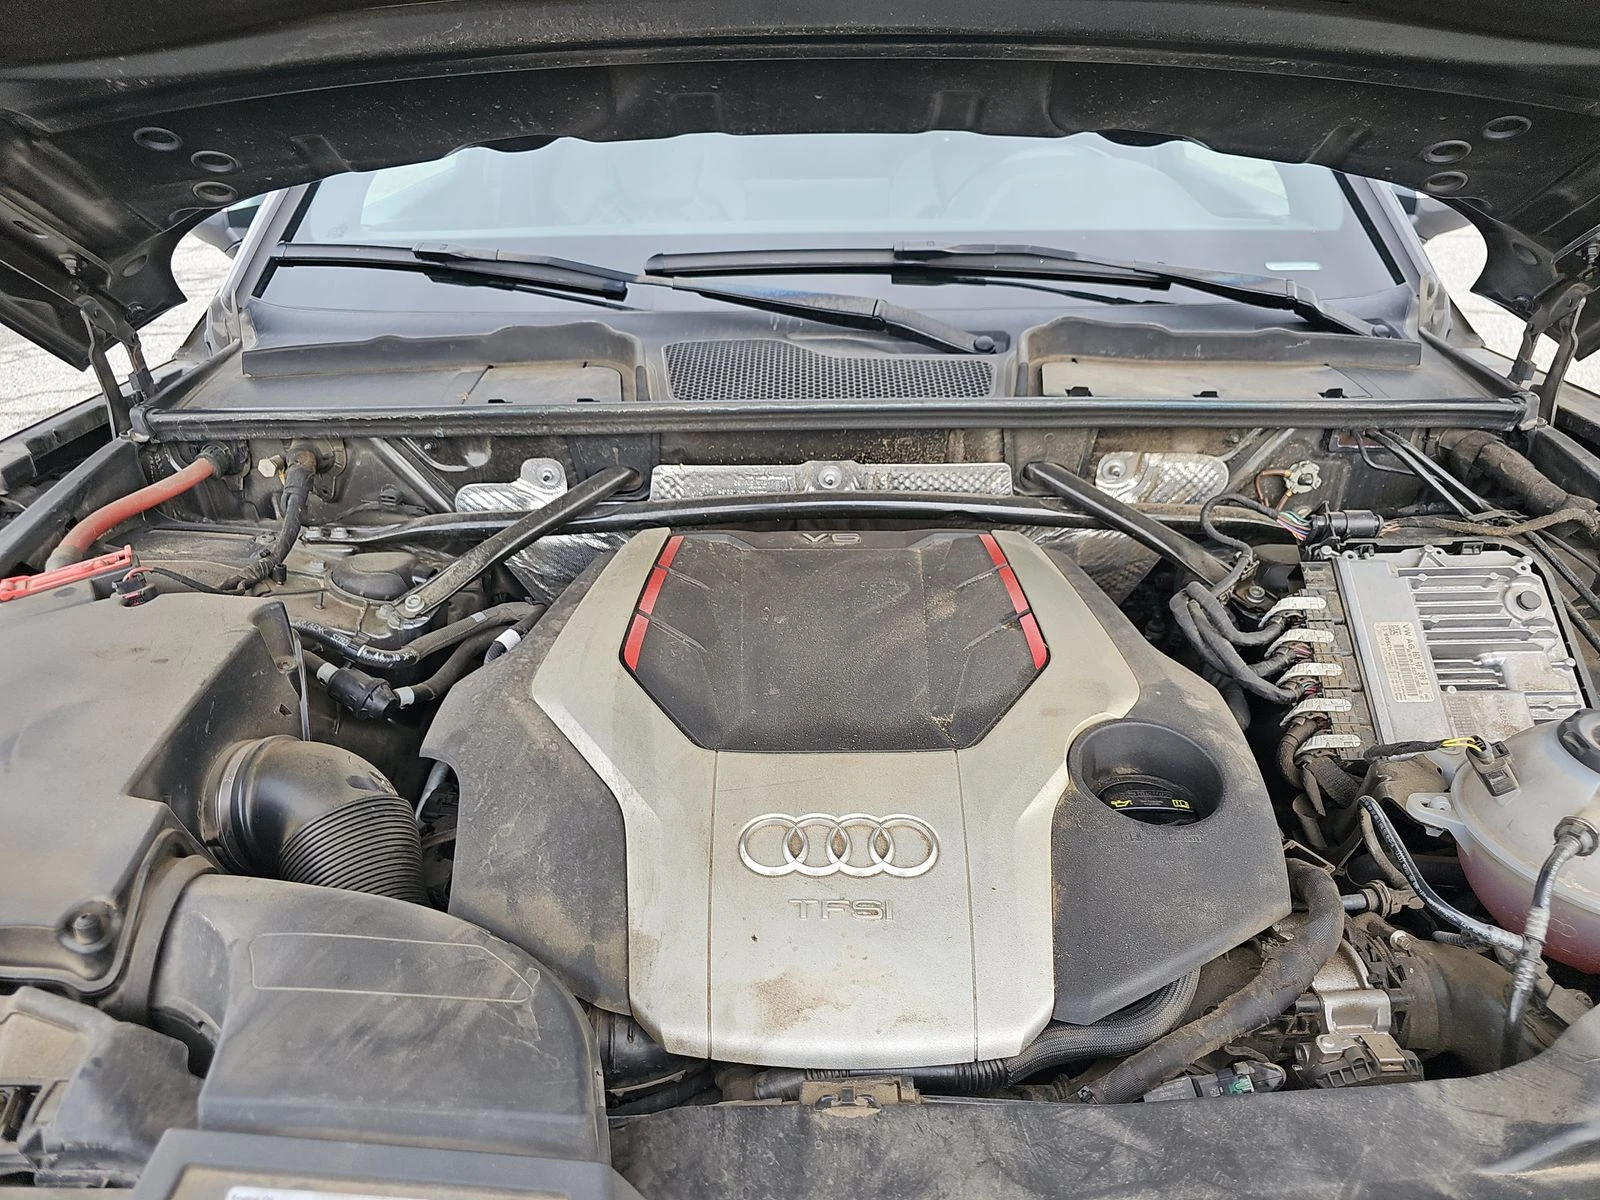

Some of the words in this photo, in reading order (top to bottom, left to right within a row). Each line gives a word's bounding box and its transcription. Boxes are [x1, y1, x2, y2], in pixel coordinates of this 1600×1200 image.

[801, 532, 862, 545] V6
[1402, 623, 1412, 638] VW
[788, 899, 894, 921] TFSI
